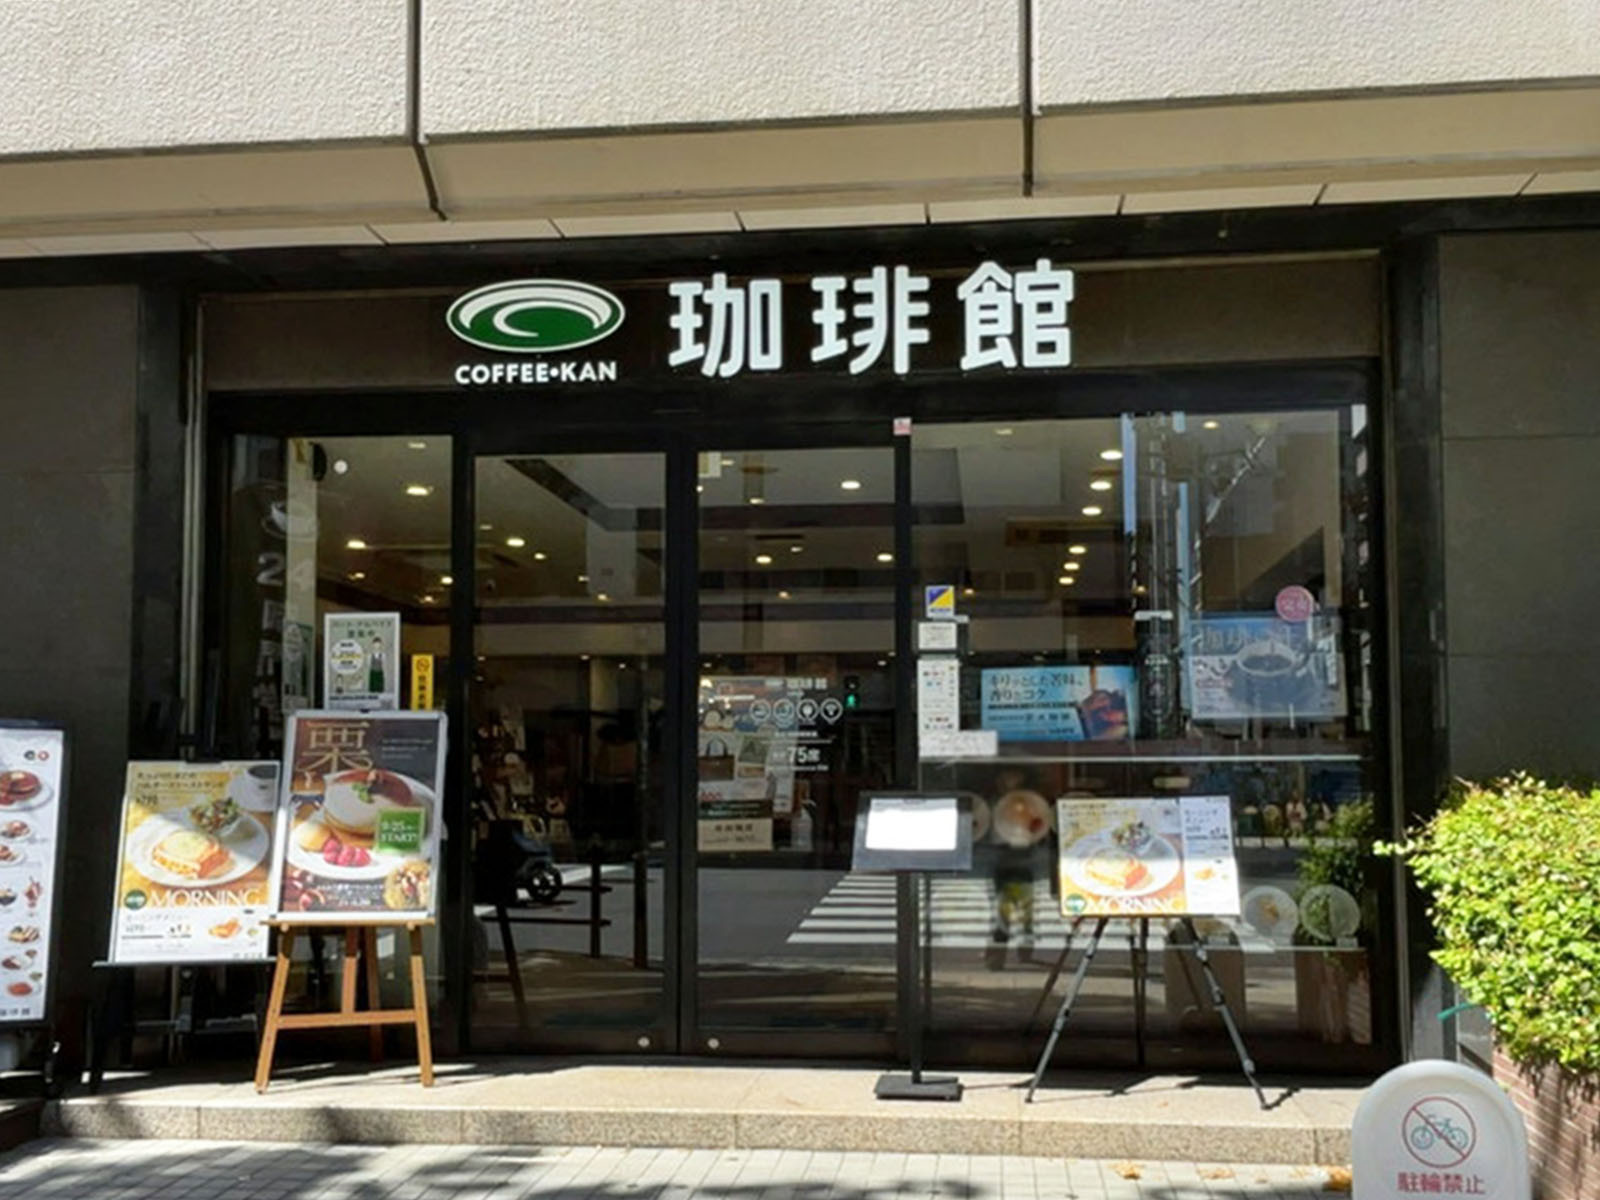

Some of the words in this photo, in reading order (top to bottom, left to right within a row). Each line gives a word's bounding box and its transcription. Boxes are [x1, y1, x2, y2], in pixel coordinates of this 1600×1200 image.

[669, 259, 1075, 377] 珈琲館
[297, 721, 373, 774] 栗
[150, 888, 261, 908] MORNING
[1088, 895, 1187, 914] MORNING
[1397, 1171, 1486, 1195] 駐輪禁止
